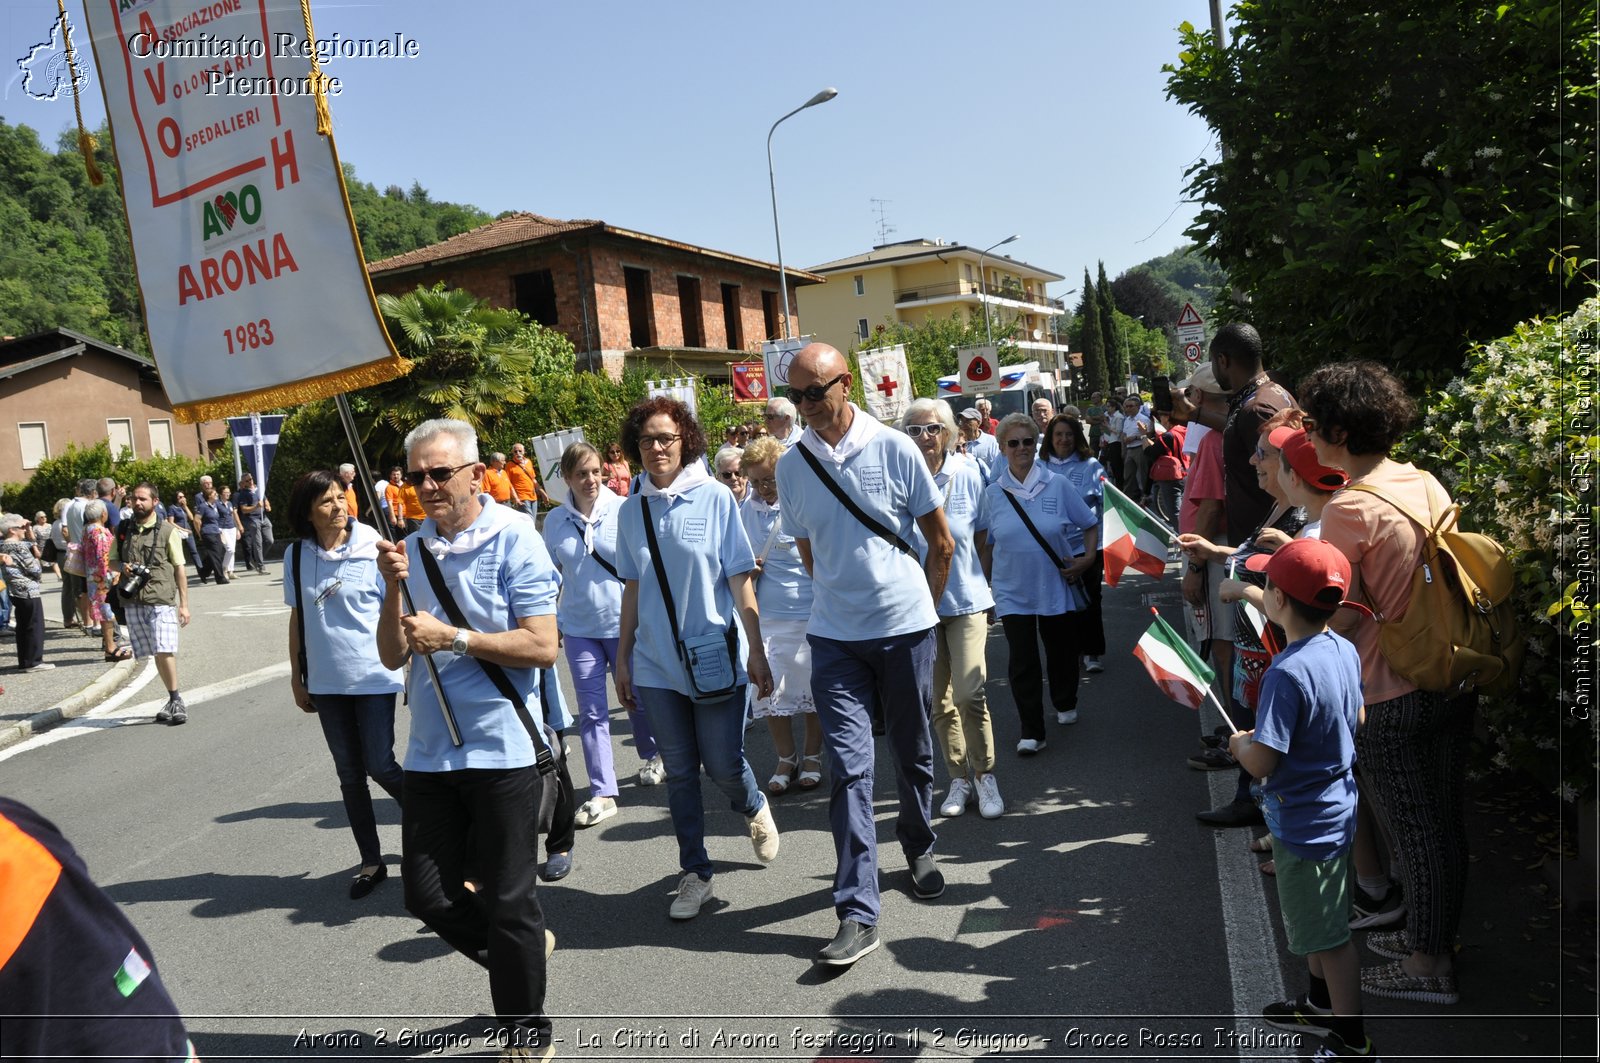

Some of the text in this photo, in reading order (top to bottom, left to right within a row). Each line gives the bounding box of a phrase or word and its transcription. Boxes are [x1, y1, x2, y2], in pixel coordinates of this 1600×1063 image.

[270, 129, 300, 191] H
[178, 232, 299, 306] ARONA
[223, 318, 275, 355] 1983
[1188, 347, 1197, 358] 30
